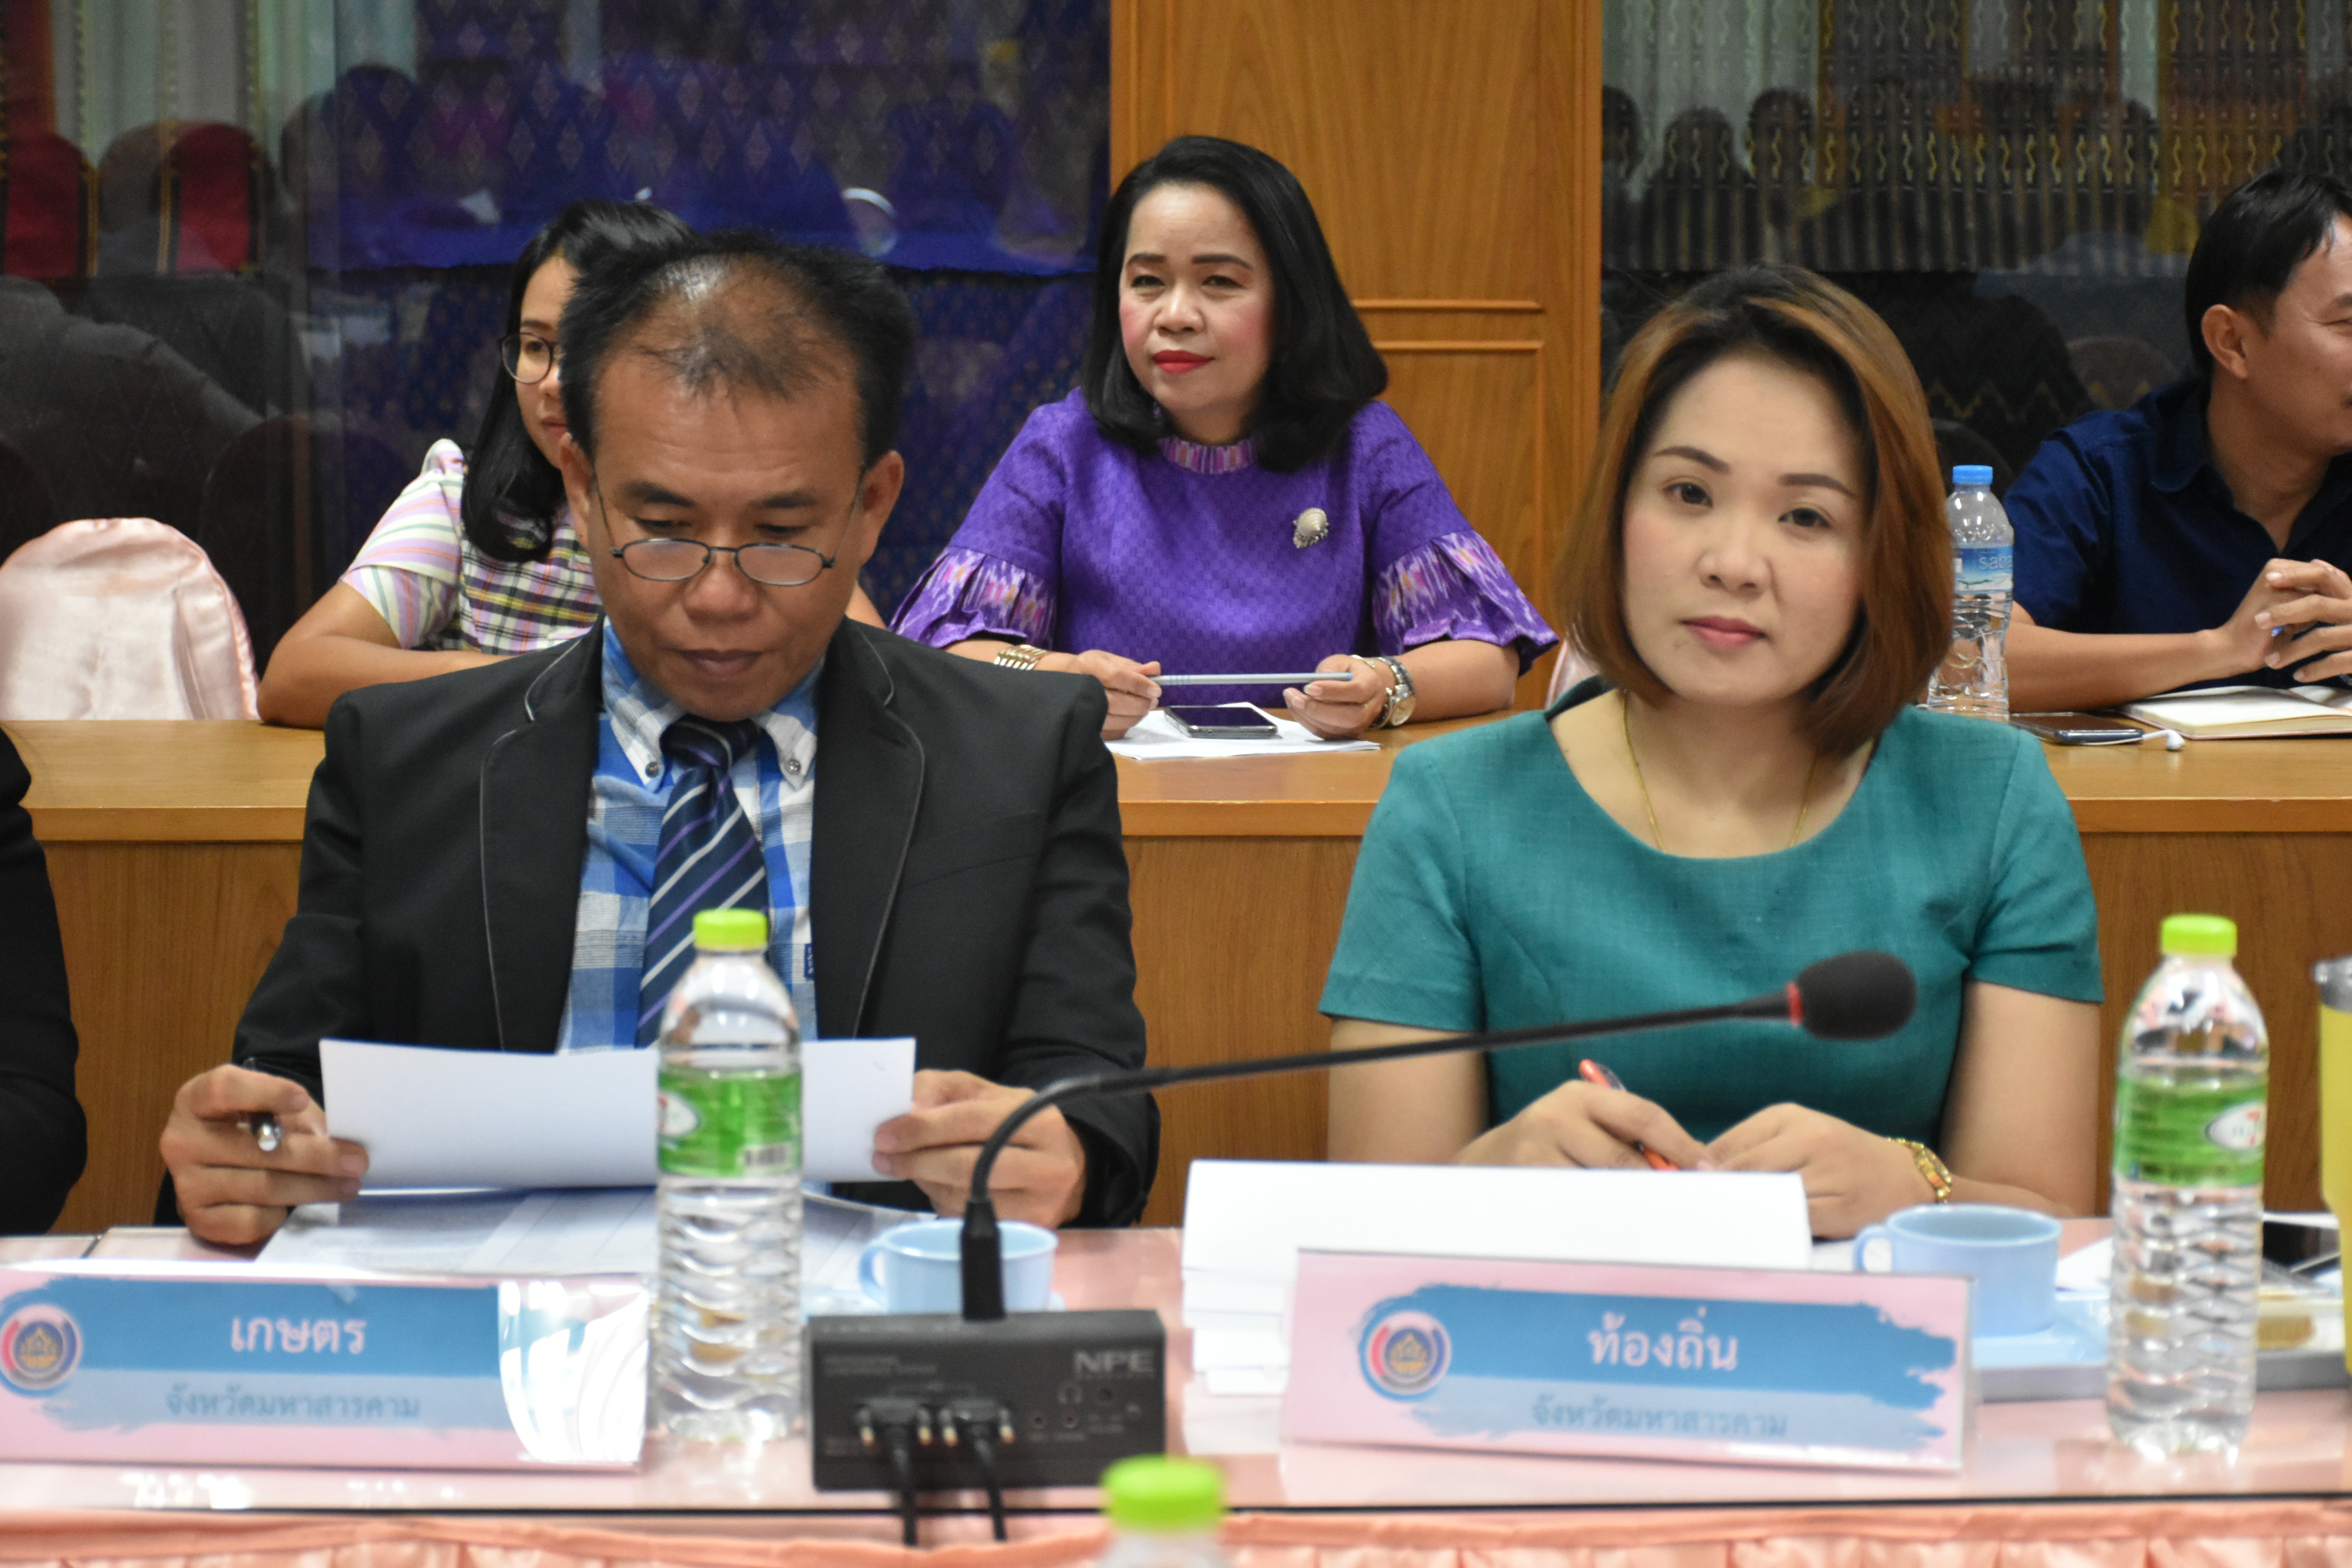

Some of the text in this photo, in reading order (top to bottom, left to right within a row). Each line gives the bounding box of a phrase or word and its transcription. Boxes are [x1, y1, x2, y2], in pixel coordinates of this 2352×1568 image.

[230, 1316, 368, 1355] เกษตร
[1588, 1306, 1738, 1371] ท้องถิ่น
[1074, 1350, 1154, 1372] NPE
